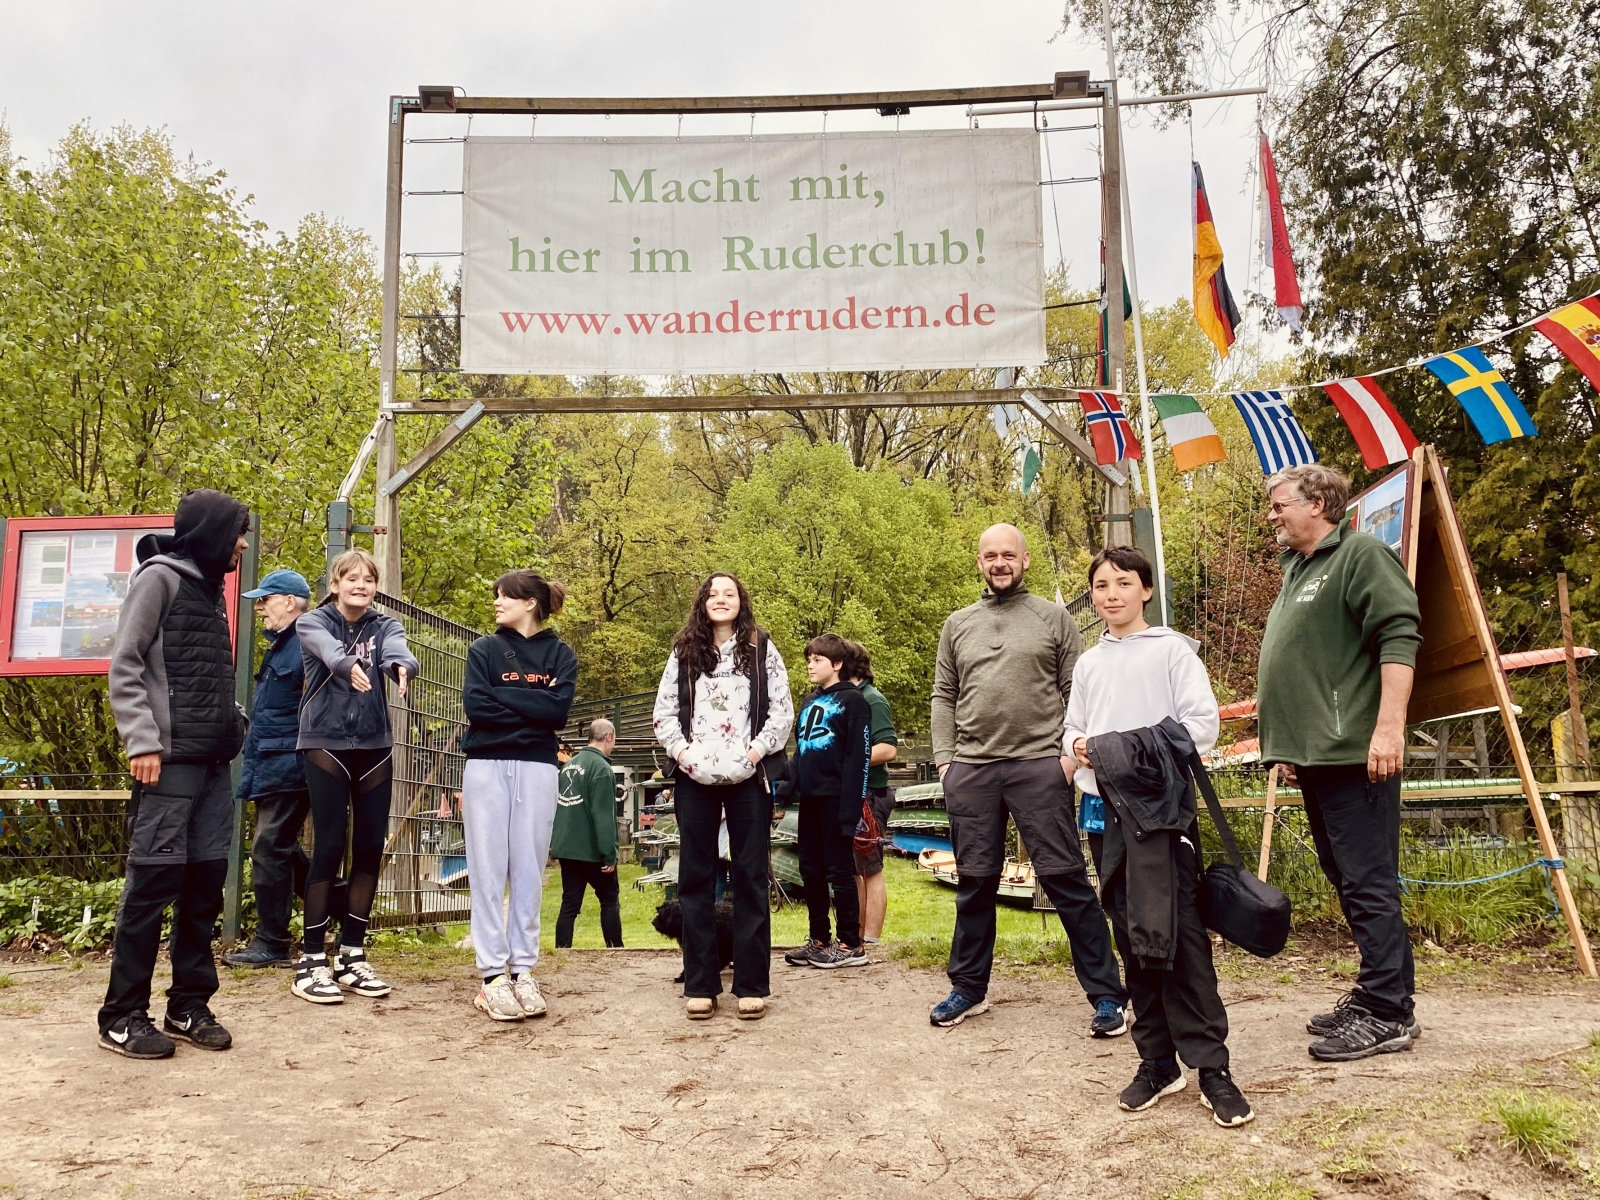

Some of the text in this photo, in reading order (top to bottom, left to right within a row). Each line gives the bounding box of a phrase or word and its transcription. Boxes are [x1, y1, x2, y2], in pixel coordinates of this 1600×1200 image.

[608, 163, 885, 208] Macht mit,
[508, 227, 986, 273] hier im Ruderclub!
[499, 292, 995, 335] www.wanderrudern.de
